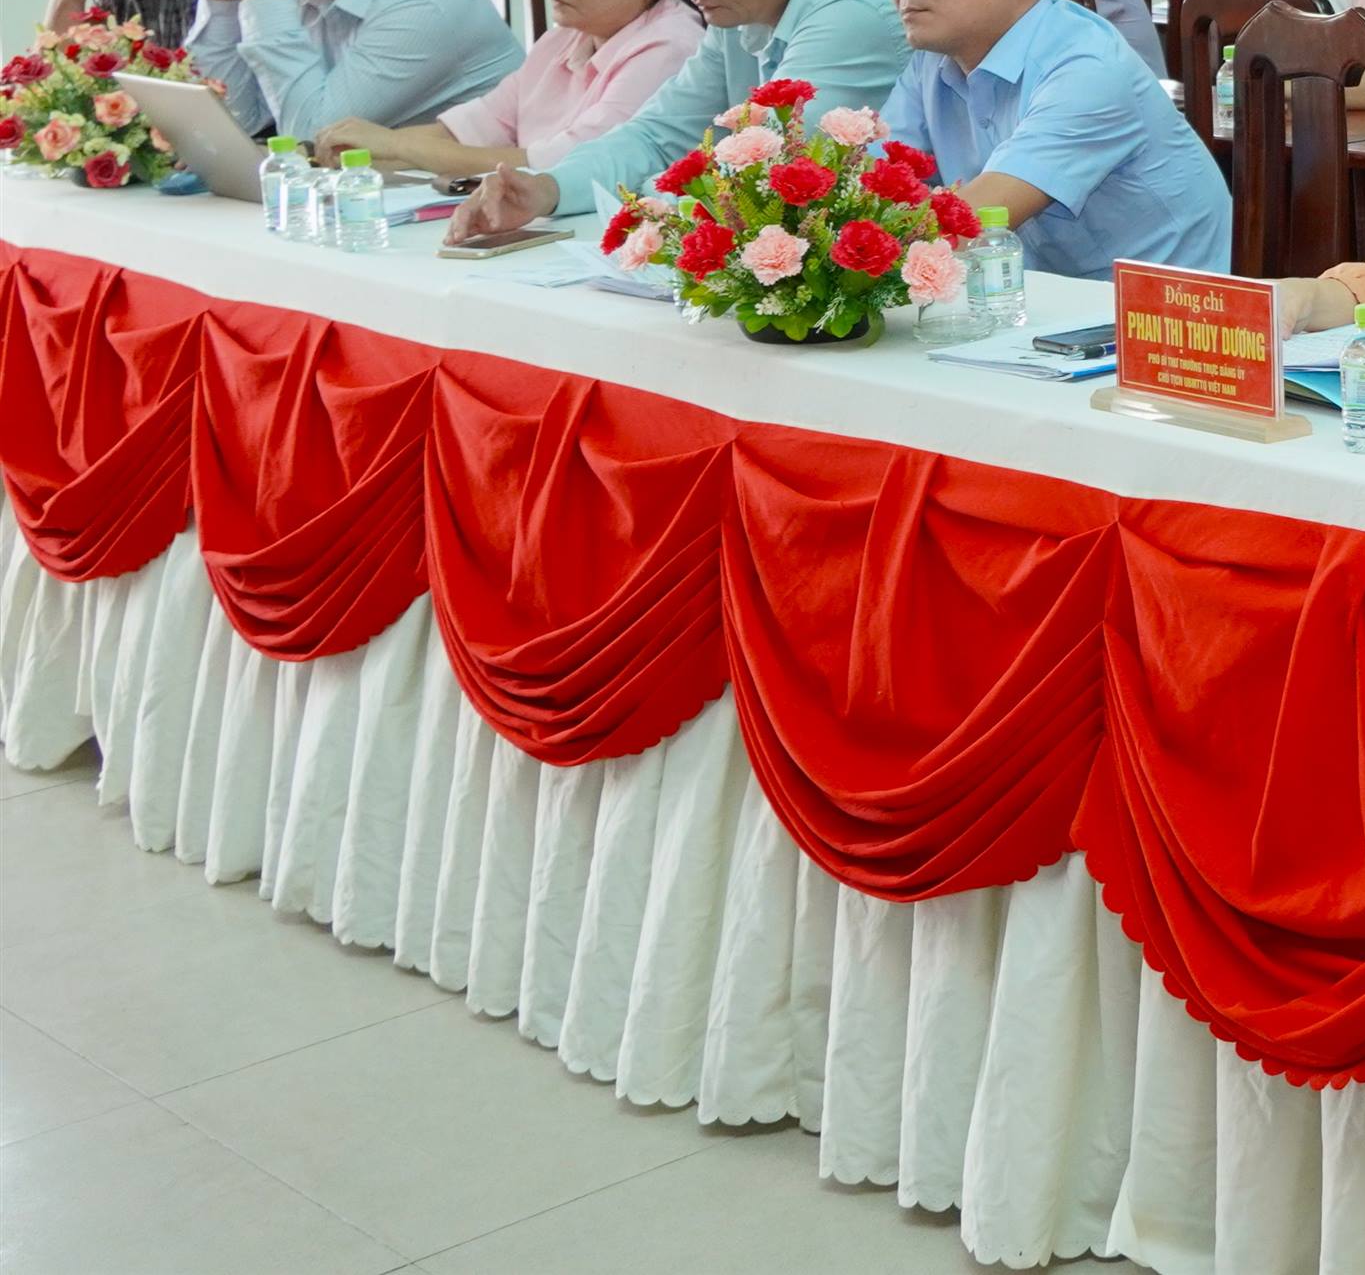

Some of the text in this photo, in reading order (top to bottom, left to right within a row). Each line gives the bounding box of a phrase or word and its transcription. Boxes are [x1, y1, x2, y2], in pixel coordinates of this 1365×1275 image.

[1165, 284, 1224, 313] Đồng chí
[1127, 311, 1266, 362] PHAN THỊ THÙY DƯƠNG
